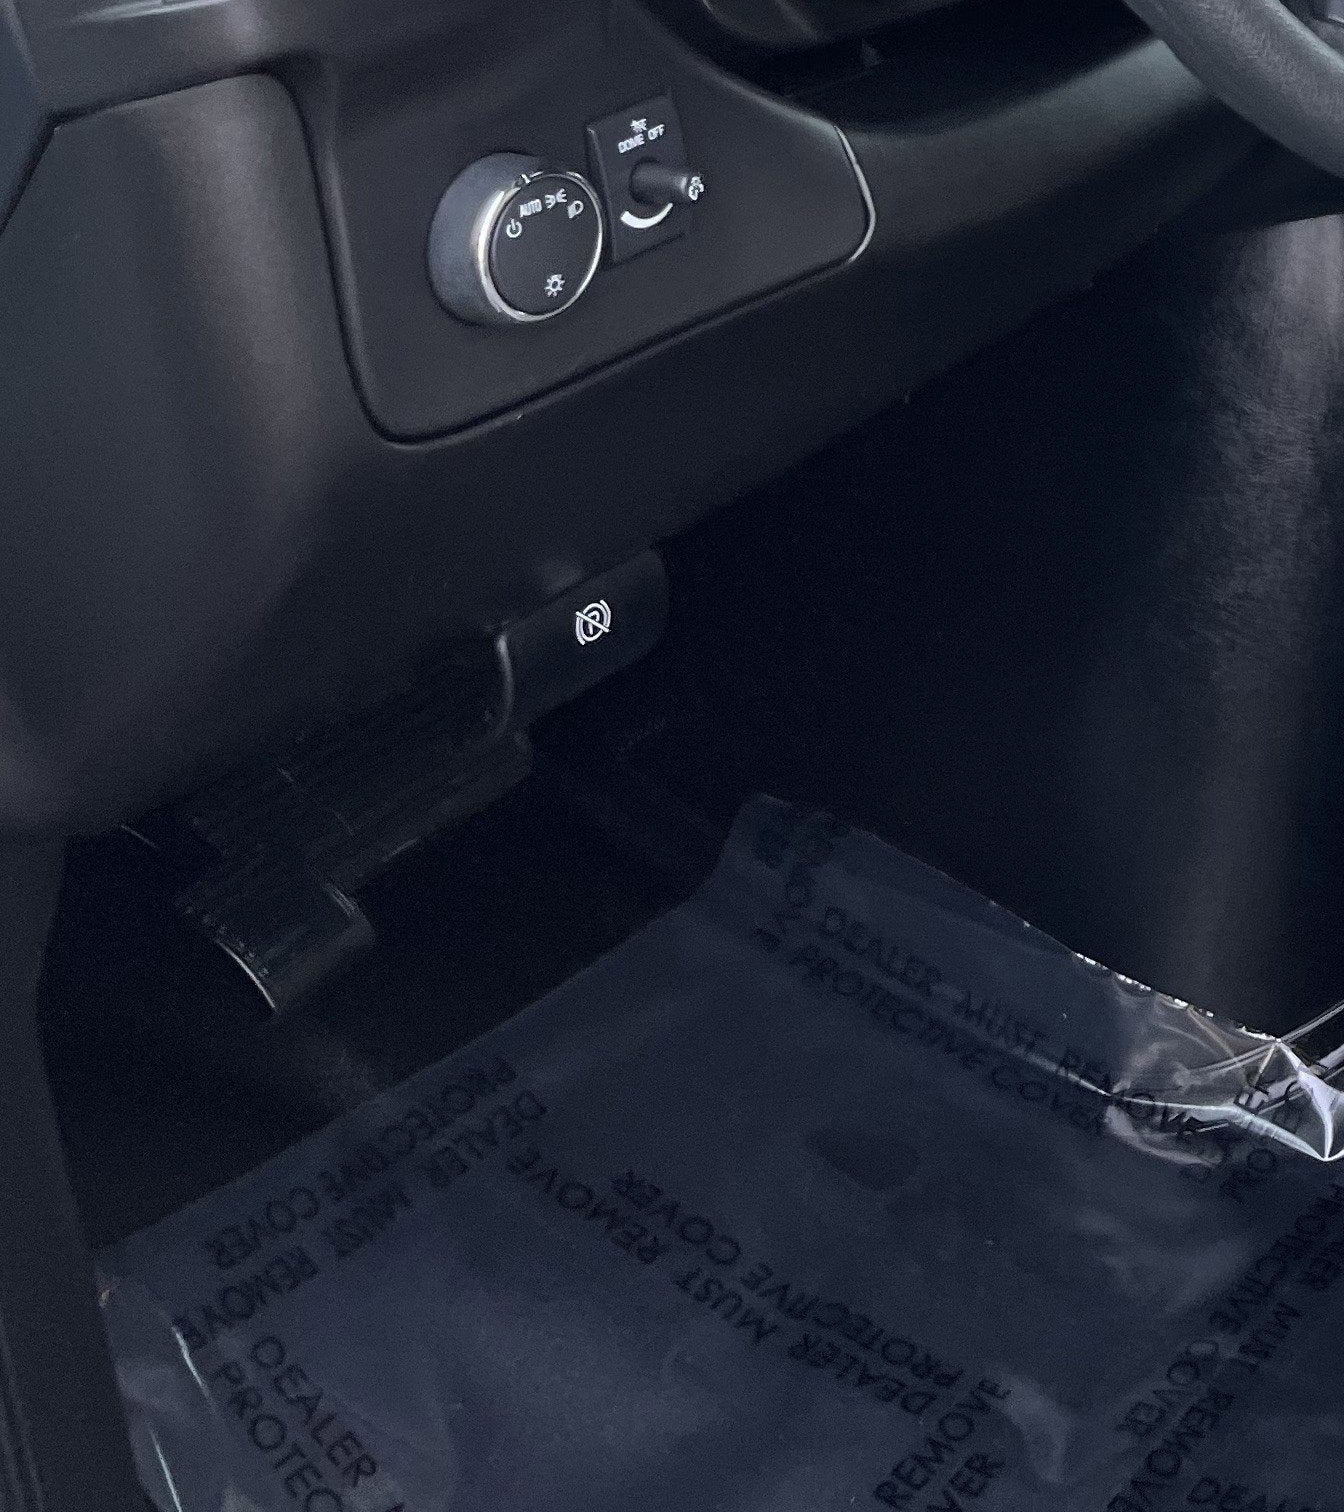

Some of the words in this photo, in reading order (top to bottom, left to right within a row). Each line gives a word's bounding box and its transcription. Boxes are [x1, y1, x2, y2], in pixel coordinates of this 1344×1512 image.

[618, 133, 645, 154] DOME
[647, 123, 666, 141] OFF
[519, 198, 542, 219] AUTO
[818, 906, 942, 998] DEALER
[788, 944, 988, 1071] PROTECTIVE
[988, 1065, 1103, 1137] COVER
[319, 1055, 518, 1202] PROTECTIVE
[420, 1090, 548, 1190] DEALER
[202, 1186, 320, 1268] COVER
[505, 1147, 672, 1266] REMOVE
[611, 1168, 742, 1267] COVER
[174, 1244, 320, 1352] REMOVE
[673, 1266, 779, 1346] MUST
[740, 1261, 965, 1389] PROTECTIVE
[249, 1334, 378, 1489] DEALER
[786, 1332, 939, 1416] DEALER
[1115, 1338, 1220, 1439] COVER
[872, 1377, 1012, 1510] REMOVE
